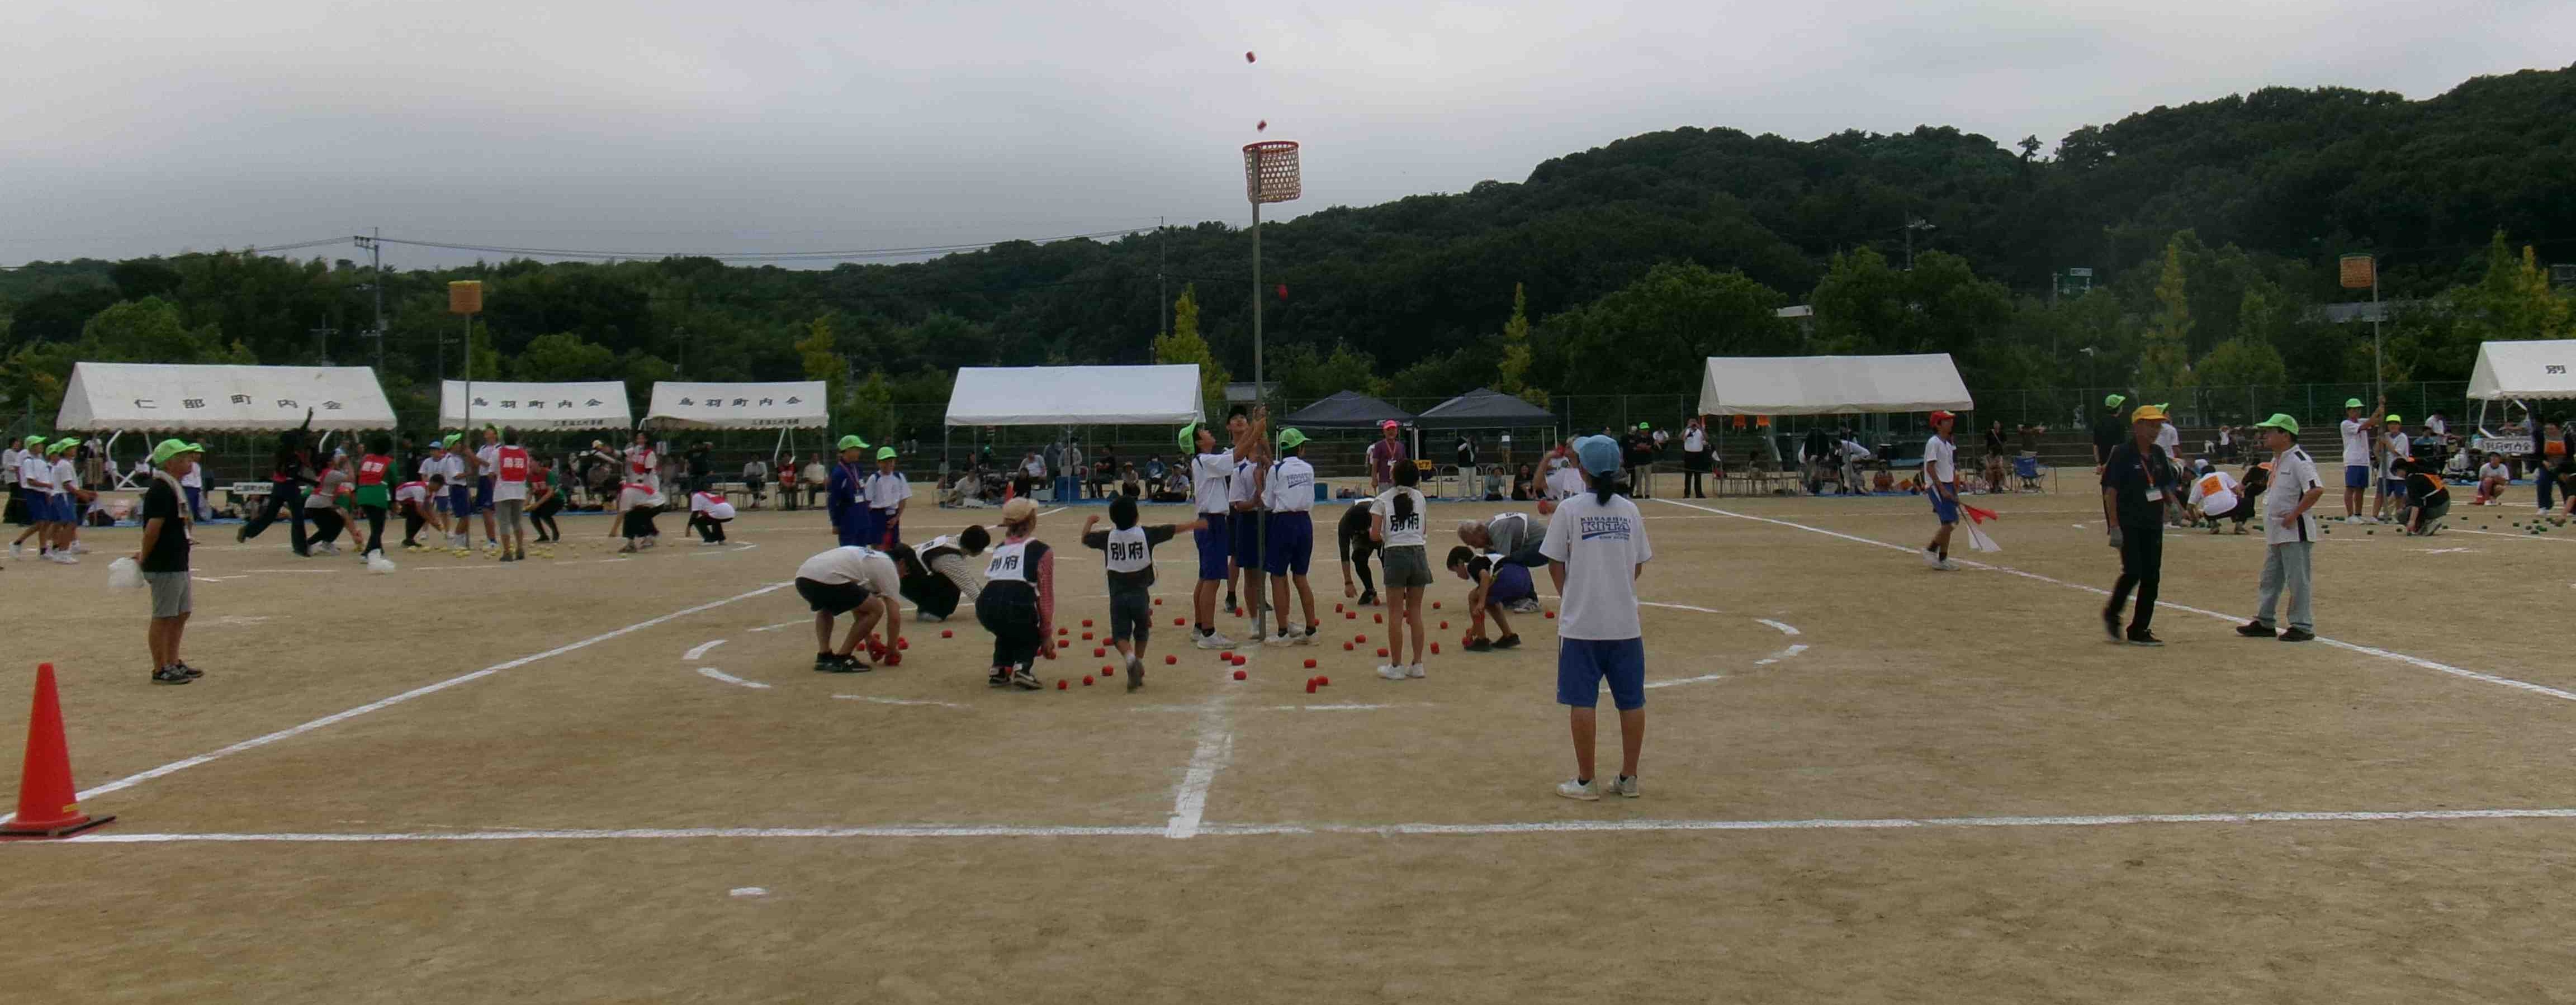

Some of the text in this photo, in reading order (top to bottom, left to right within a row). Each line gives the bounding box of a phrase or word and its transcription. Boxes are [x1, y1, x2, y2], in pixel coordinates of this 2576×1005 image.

[134, 394, 343, 410] 仁部町内会
[1581, 520, 1631, 533] KITA
[1110, 541, 1143, 561] 別府
